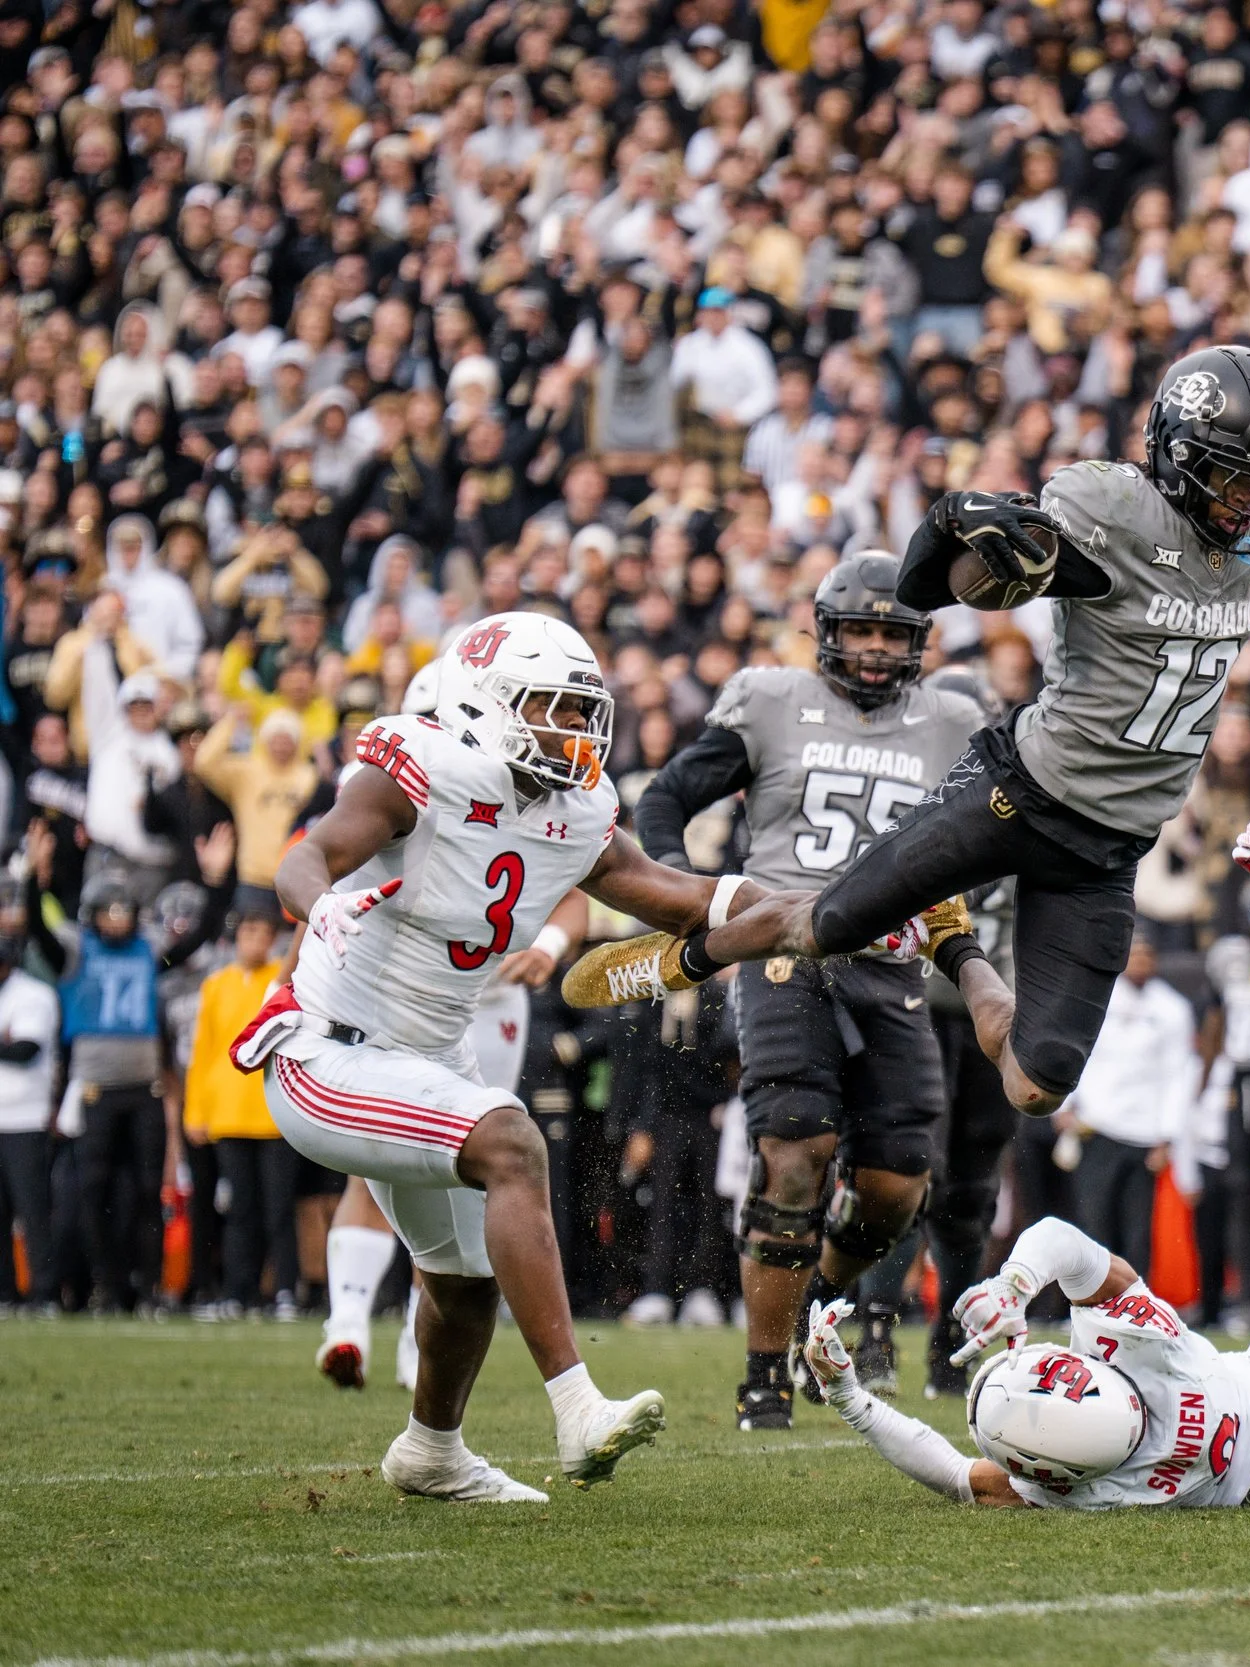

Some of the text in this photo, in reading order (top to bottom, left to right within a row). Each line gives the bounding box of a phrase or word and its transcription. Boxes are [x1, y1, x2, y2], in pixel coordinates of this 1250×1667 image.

[1118, 637, 1241, 755] 12
[801, 741, 923, 782] COLORADO
[464, 798, 505, 829] XII
[447, 850, 526, 971] 3
[101, 975, 147, 1030] 14
